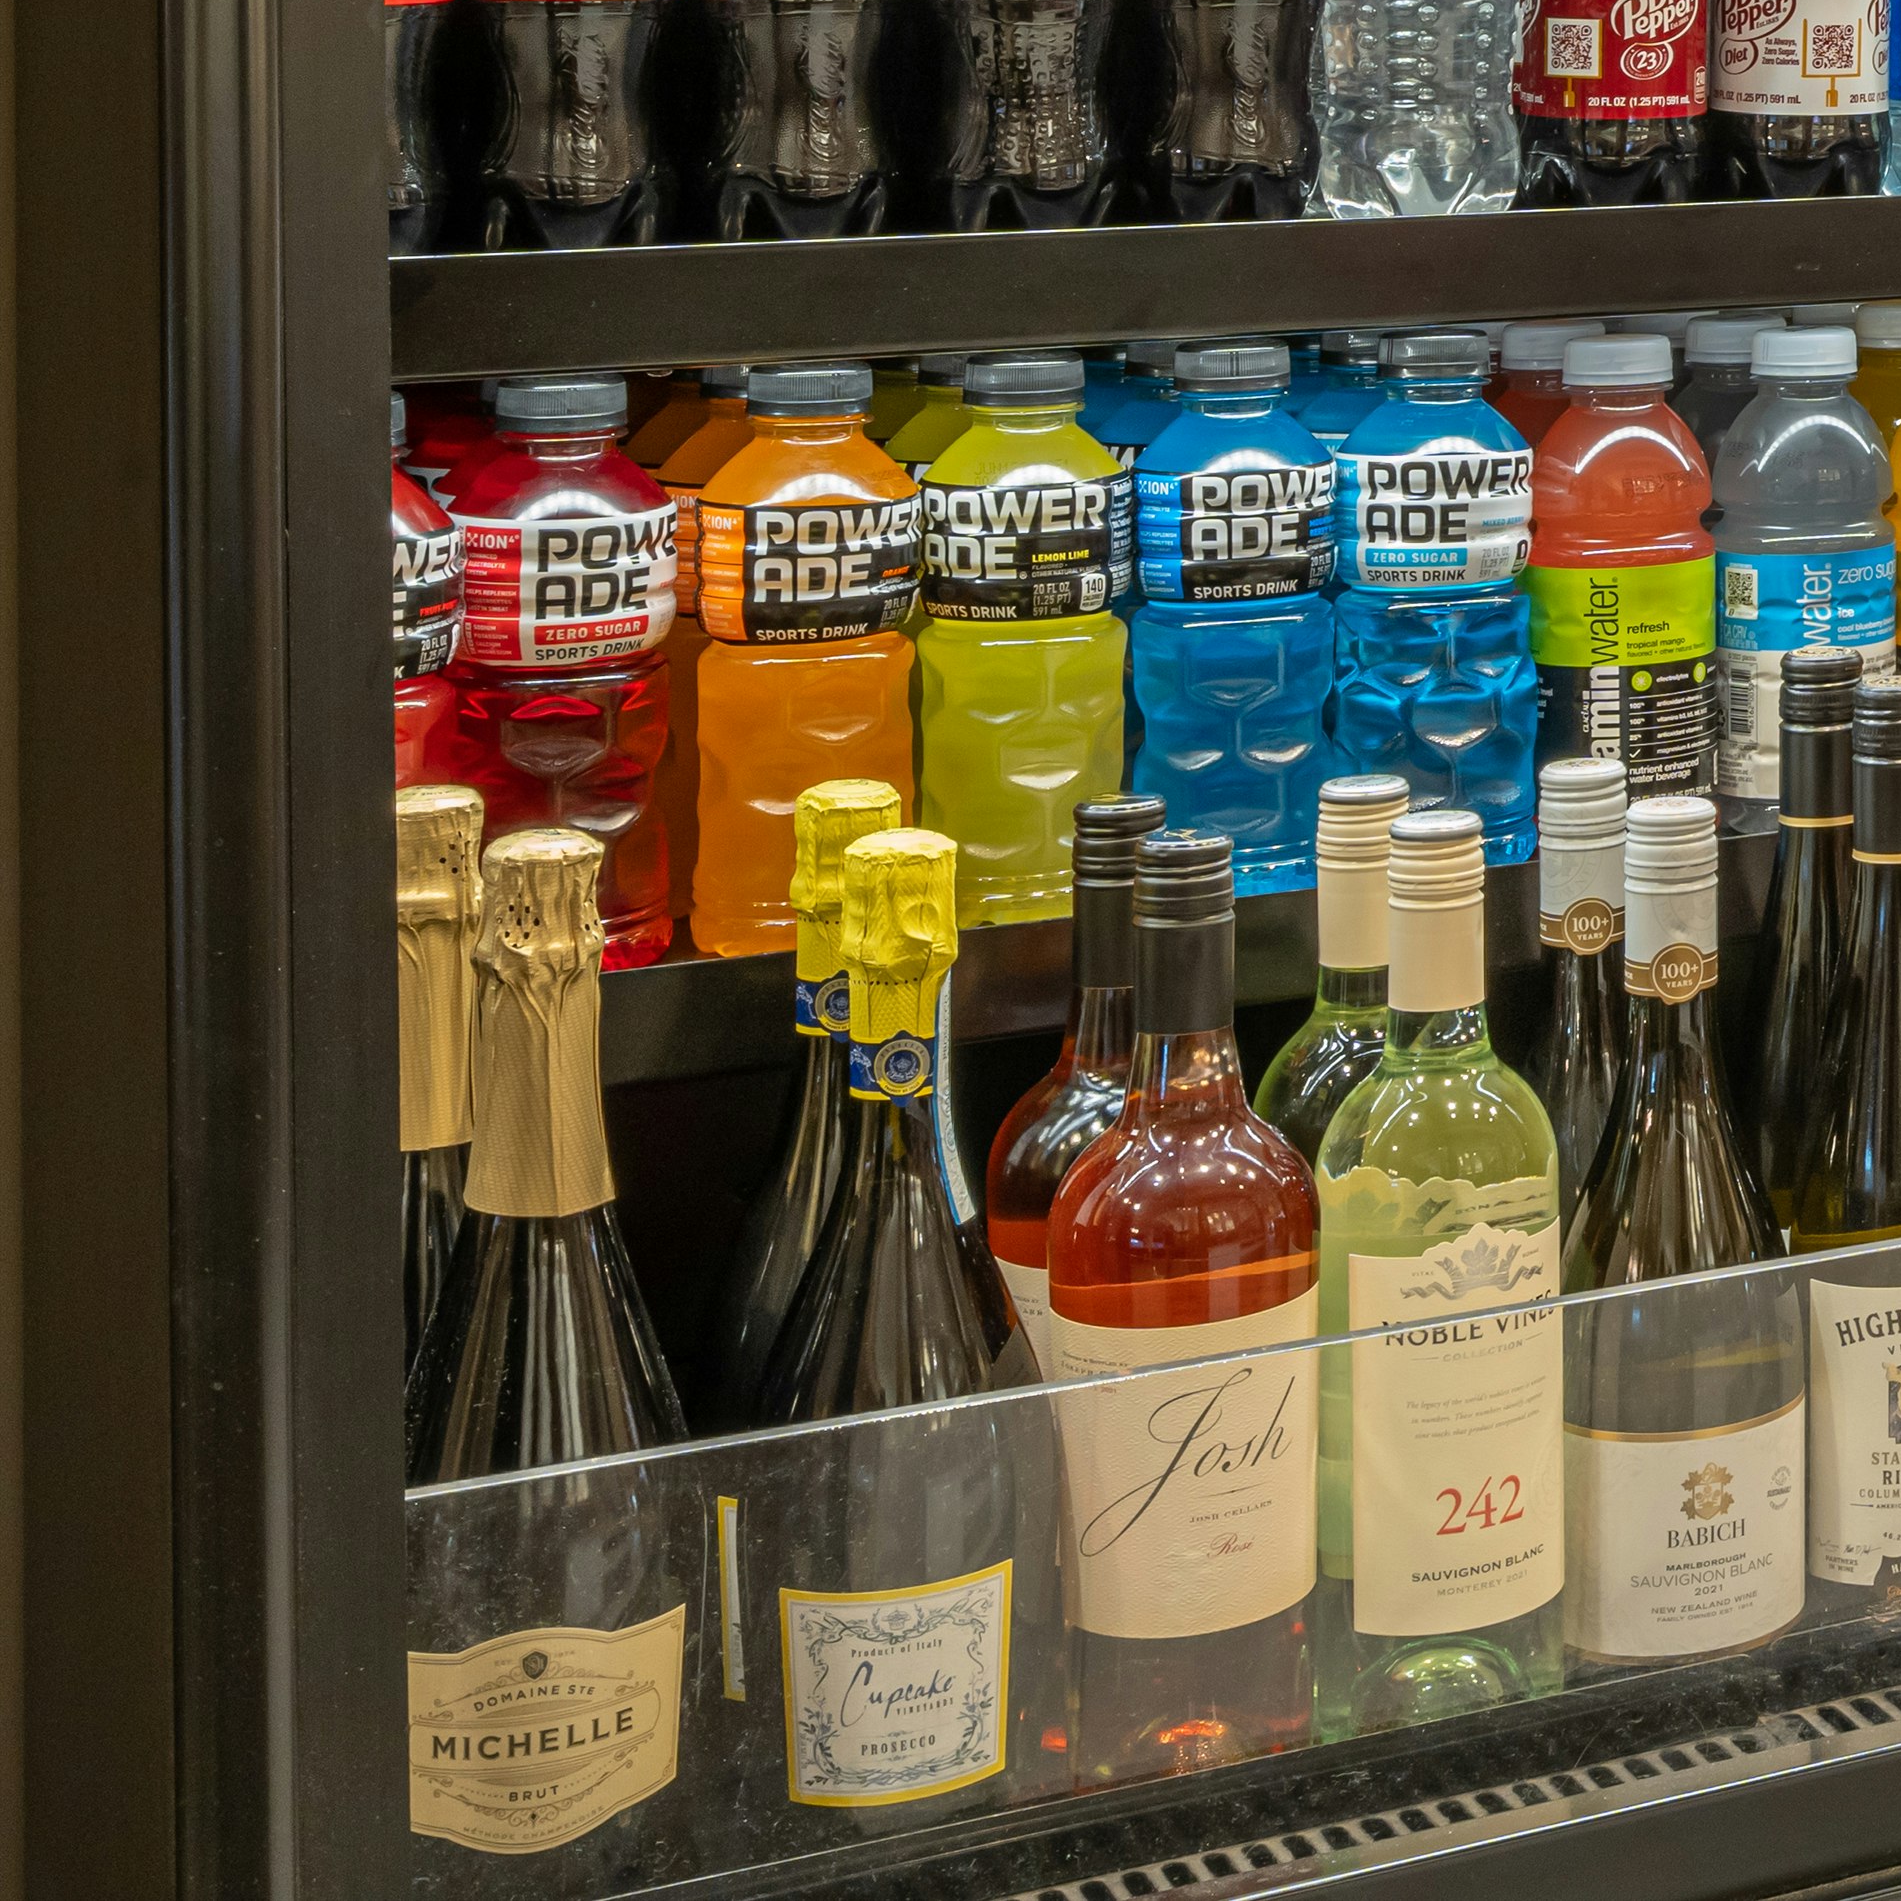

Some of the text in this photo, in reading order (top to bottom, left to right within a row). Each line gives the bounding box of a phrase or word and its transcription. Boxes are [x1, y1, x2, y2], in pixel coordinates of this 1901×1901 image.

[923, 487, 1107, 536] POWER
[1032, 550, 1089, 563] LEMON LIME
[754, 554, 873, 602] ADE
[1084, 578, 1103, 593] 140
[535, 566, 651, 621] ADE
[545, 620, 642, 640] ZERO SUGAR
[756, 621, 868, 642] SPORTS DRINK
[1627, 621, 1669, 635] refresh
[535, 638, 644, 661] SPORTS DRINK
[1080, 1368, 1296, 1558] Josh
[1436, 1474, 1525, 1536] 242
[1667, 1518, 1745, 1549] BABICH
[1411, 1544, 1545, 1583] SAUVIGNON BLANC
[1630, 1553, 1773, 1589] SAUVIGNON BLANC
[1666, 1552, 1746, 1572] MARLBOROUGH
[1437, 1570, 1528, 1596] MONTEREY 2021
[1694, 1584, 1724, 1597] 2021
[431, 1707, 635, 1761] MICHELLE
[508, 1785, 561, 1802] BRUT
